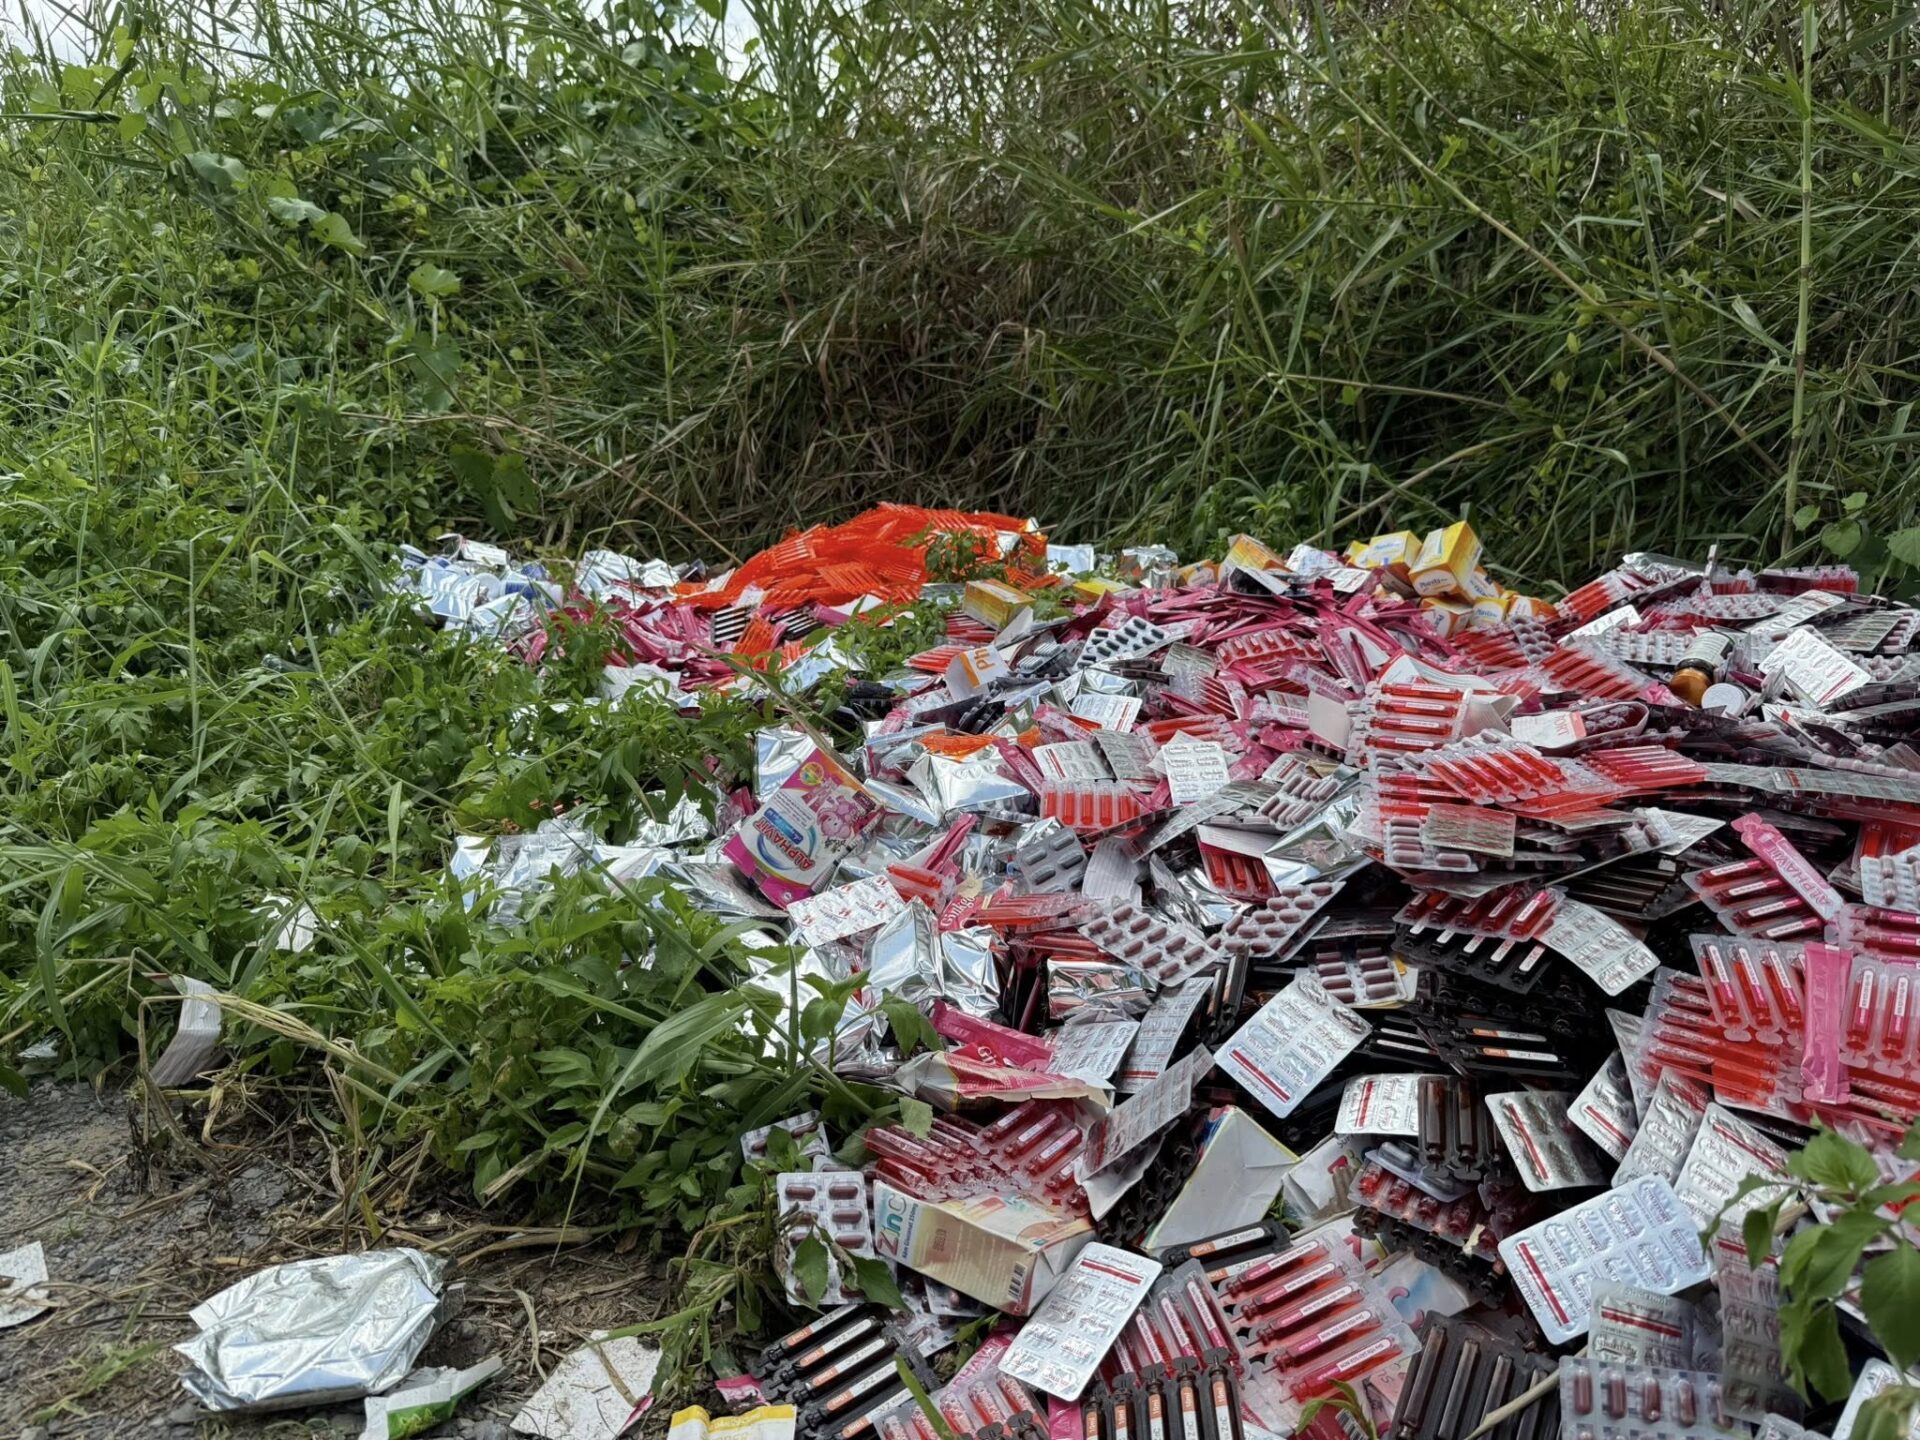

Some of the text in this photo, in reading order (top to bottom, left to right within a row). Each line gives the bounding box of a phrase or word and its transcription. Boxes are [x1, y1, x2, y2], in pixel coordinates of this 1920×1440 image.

[754, 816, 815, 871] ALPHAVIT
[1765, 846, 1834, 907] ALPHAVIT
[940, 894, 976, 928] Ginkgo
